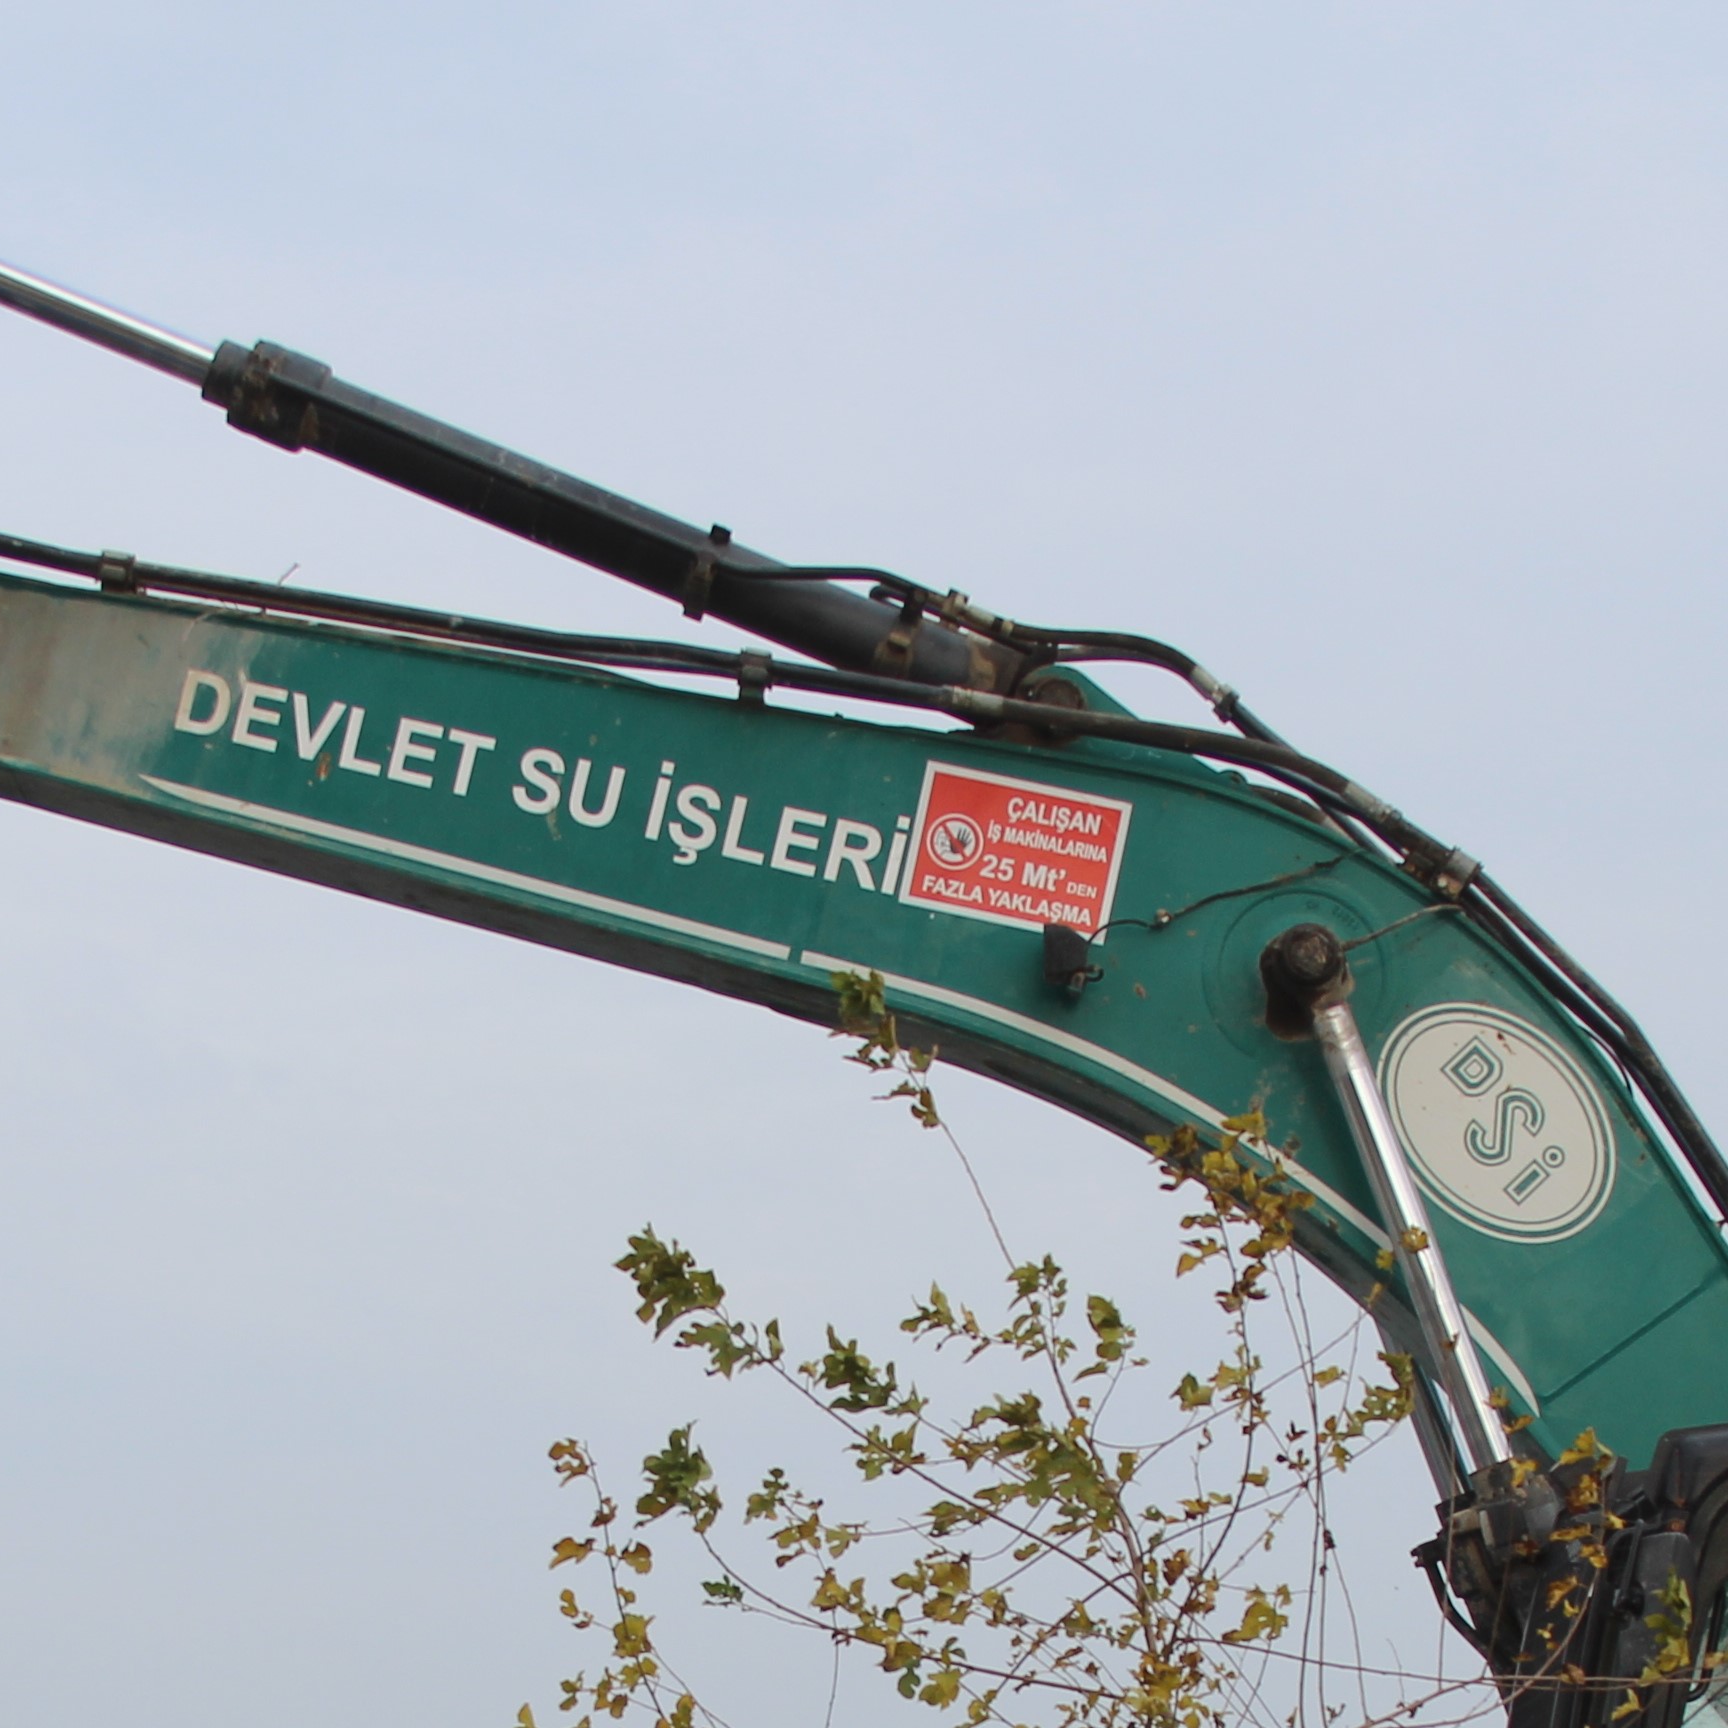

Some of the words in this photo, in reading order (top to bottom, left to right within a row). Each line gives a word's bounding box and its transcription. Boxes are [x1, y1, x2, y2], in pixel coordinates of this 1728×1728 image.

[174, 669, 497, 797] DEVLET
[511, 747, 626, 828] SU
[644, 760, 911, 896] İŞLERİ
[1007, 797, 1102, 835] ÇALIŞAN
[987, 820, 1002, 844] İŞ
[1003, 826, 1108, 863] MAKİNALARINA
[979, 854, 1015, 882] 25
[1067, 881, 1097, 899] DEN
[922, 874, 983, 904] FAZLA
[988, 888, 1092, 926] YAKLAŞMA
